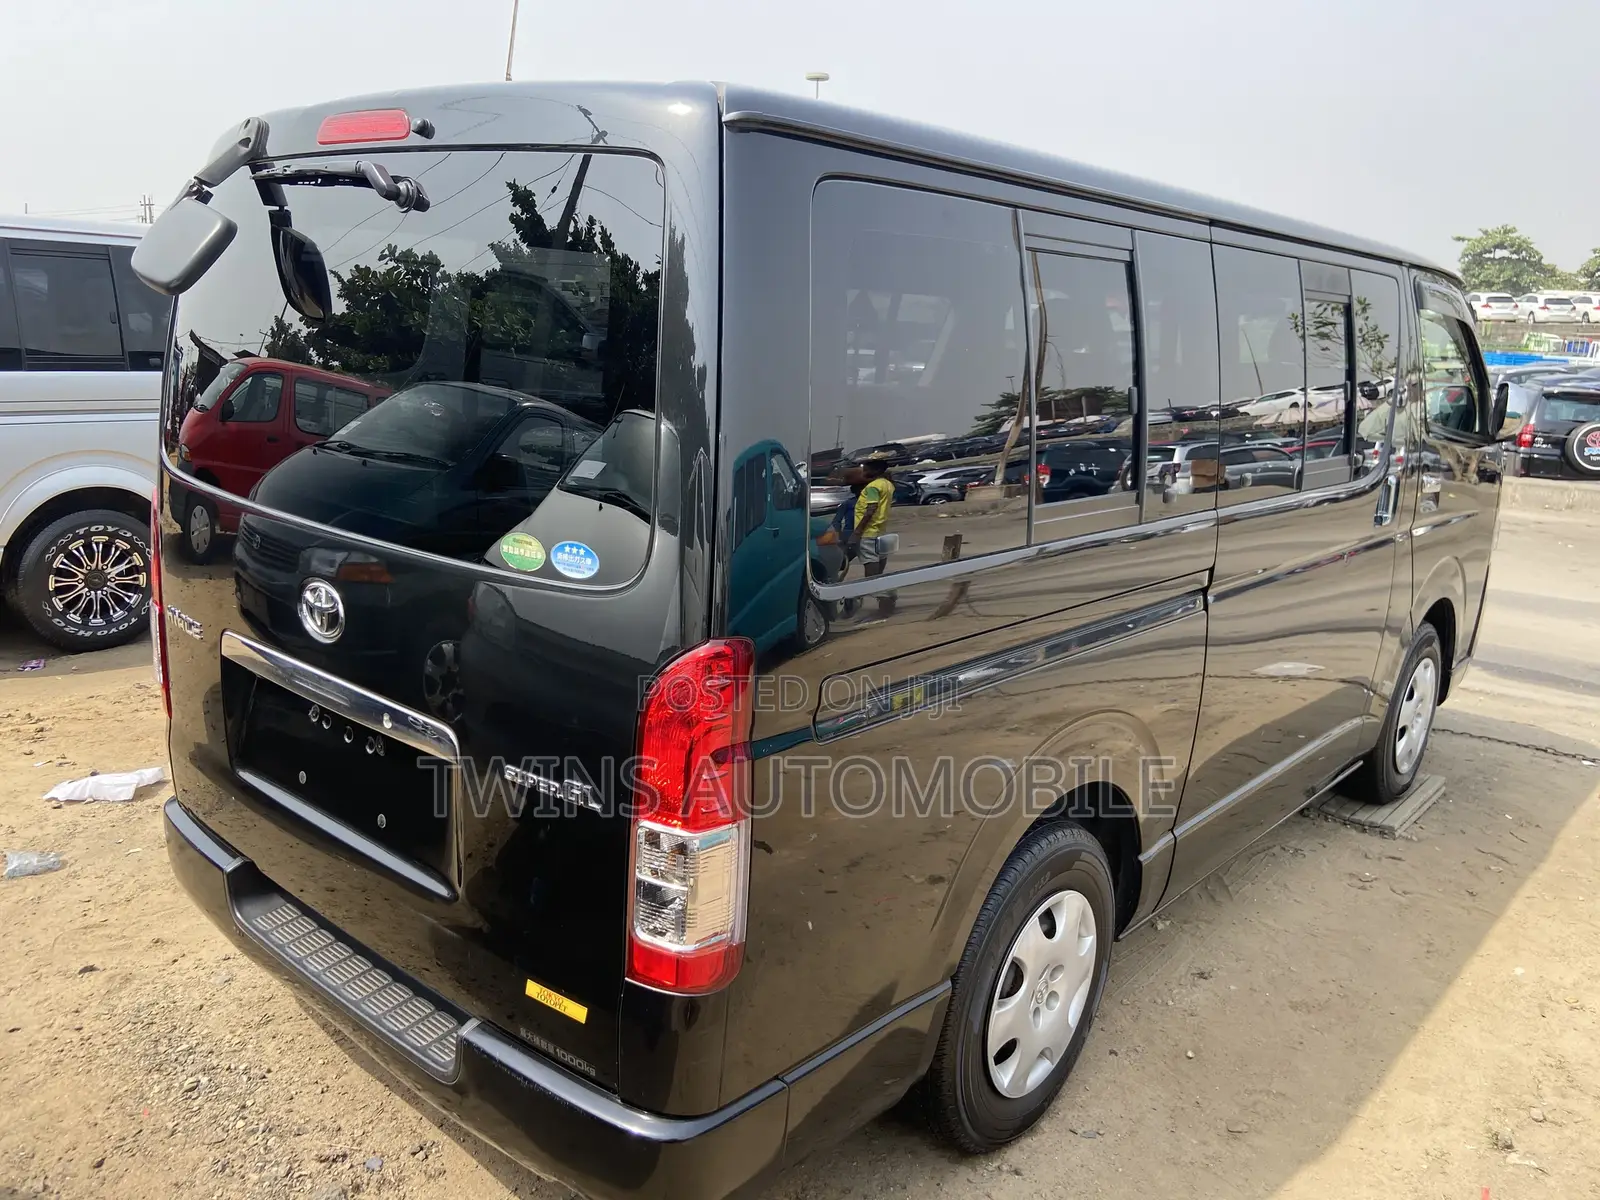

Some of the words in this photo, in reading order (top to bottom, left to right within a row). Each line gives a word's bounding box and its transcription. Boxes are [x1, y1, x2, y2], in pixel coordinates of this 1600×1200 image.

[75, 524, 132, 537] TOYO
[97, 617, 138, 636] TOYO
[536, 992, 569, 1012] TOYOPET
[540, 987, 564, 1004] TOKYO
